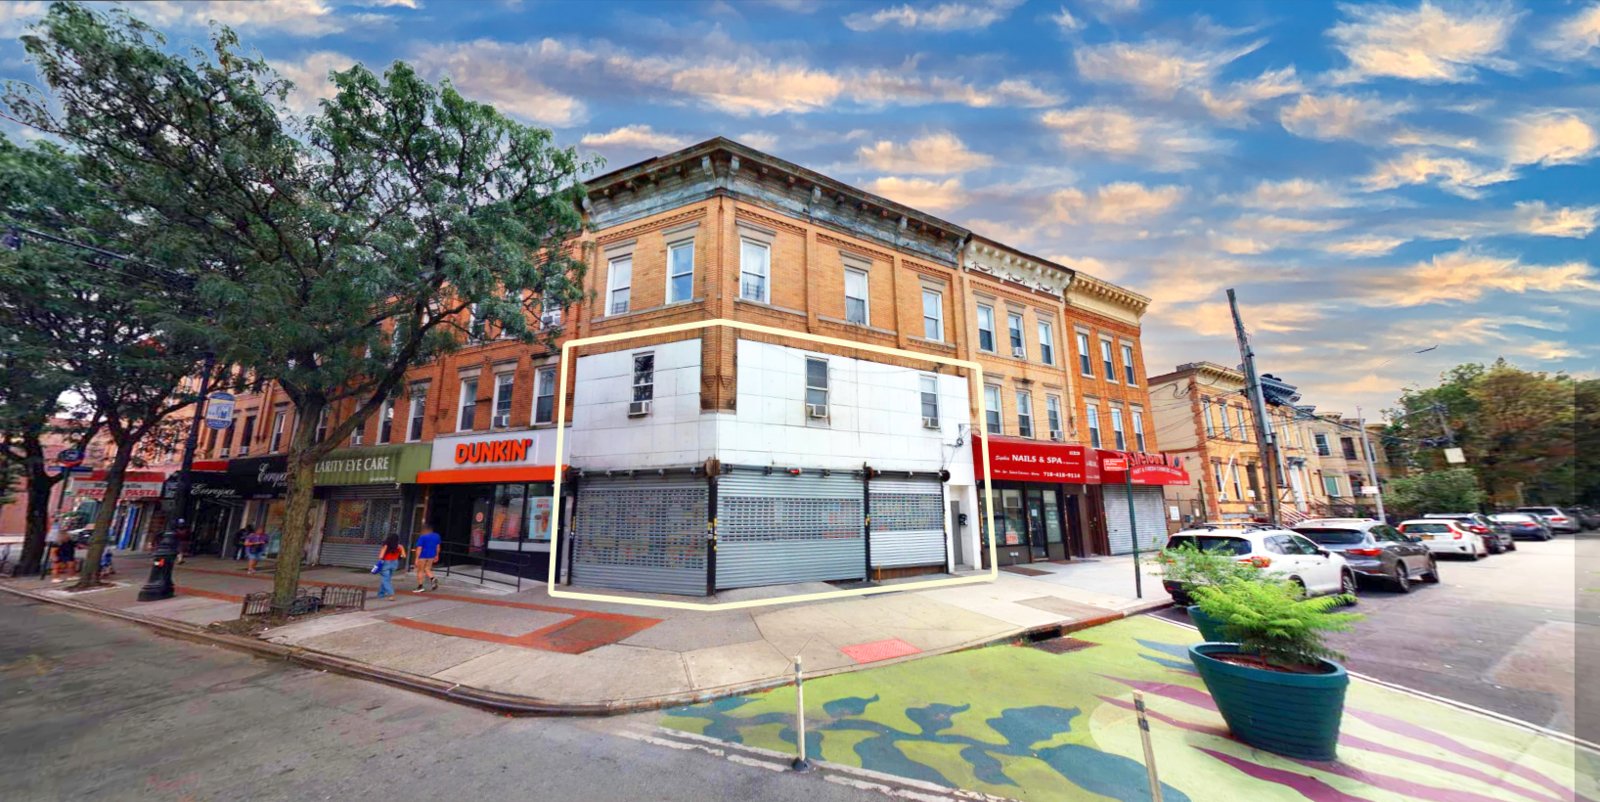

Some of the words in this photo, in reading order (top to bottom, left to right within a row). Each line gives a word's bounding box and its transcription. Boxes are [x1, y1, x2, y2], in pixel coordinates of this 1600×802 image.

[455, 439, 532, 464] DUNKIN'
[314, 460, 345, 473] LARITY
[345, 458, 363, 472] EYE
[363, 456, 390, 471] CARE
[1012, 454, 1037, 463] NAILS
[1038, 456, 1046, 464] &
[1046, 456, 1063, 465] SPA
[124, 489, 159, 497] PASTA
